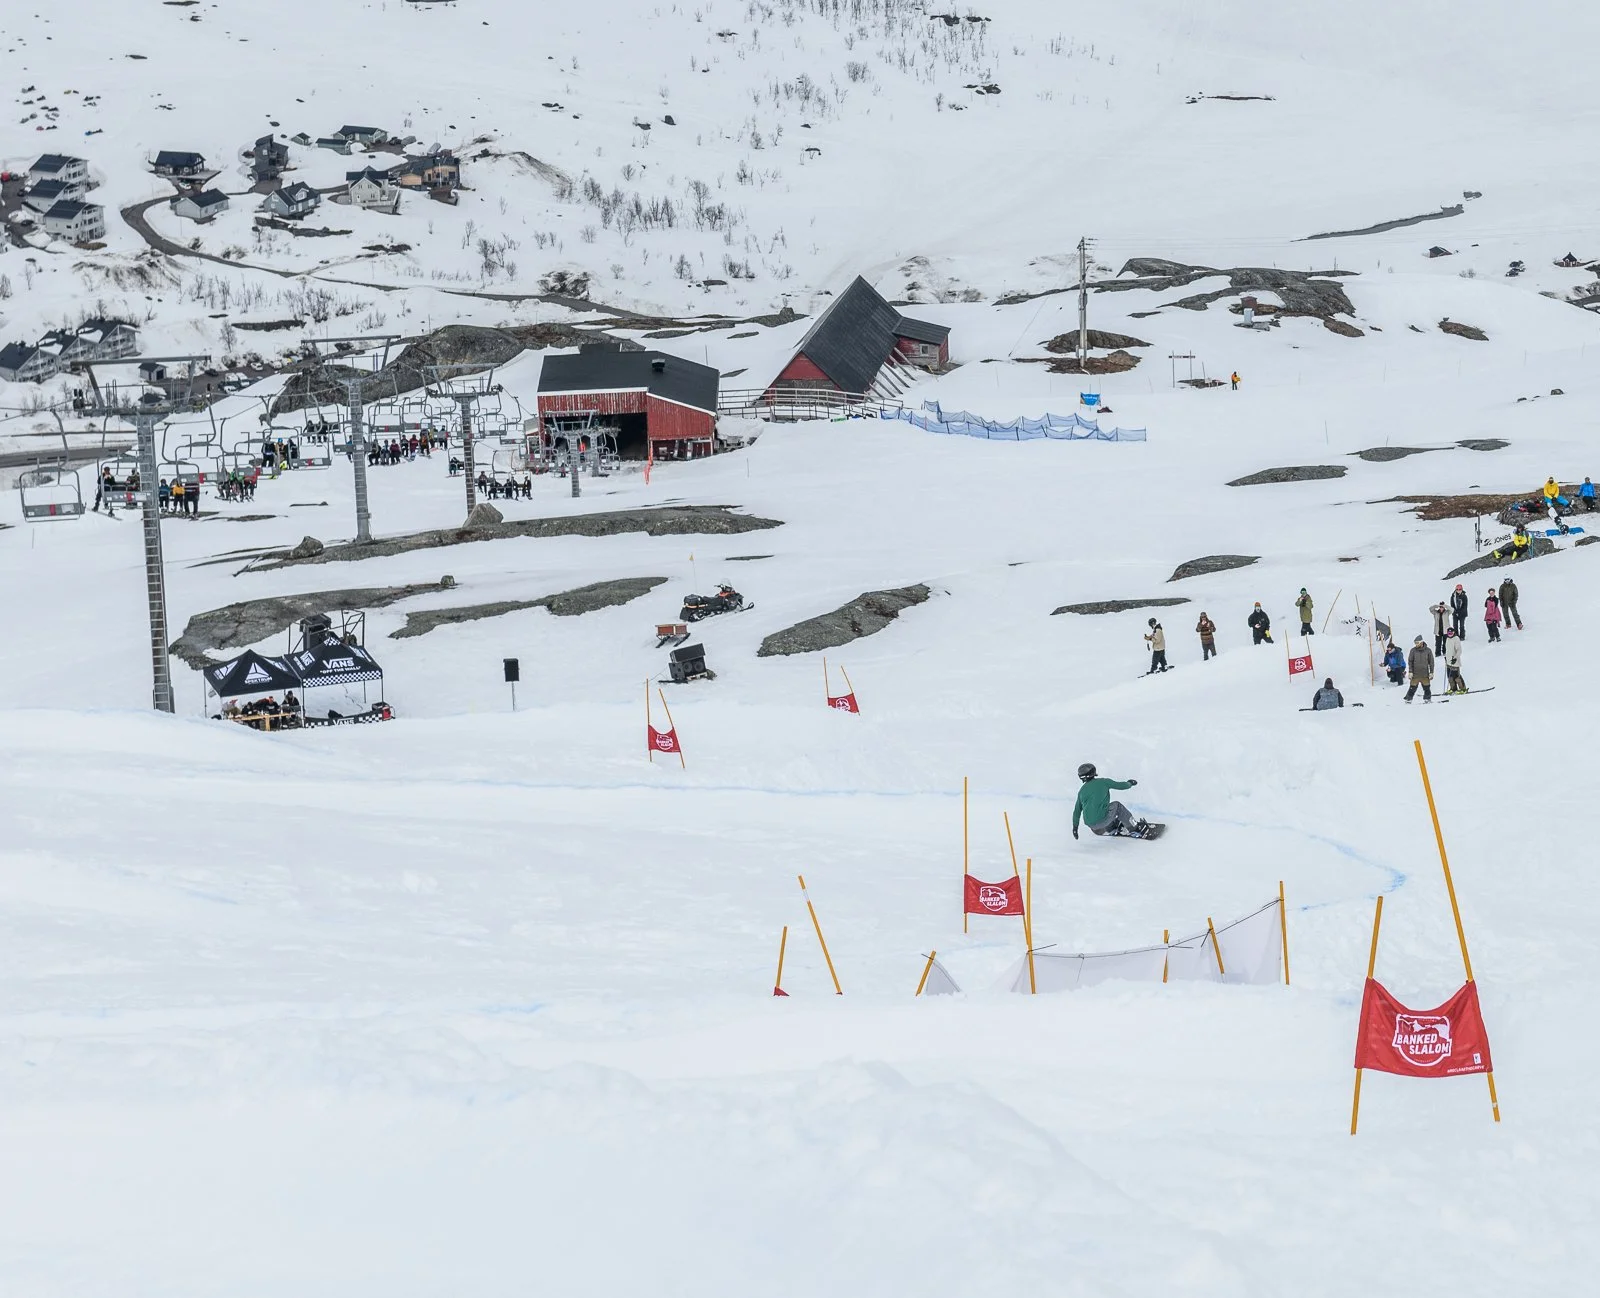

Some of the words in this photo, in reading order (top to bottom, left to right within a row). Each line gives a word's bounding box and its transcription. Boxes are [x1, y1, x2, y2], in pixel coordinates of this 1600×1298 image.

[322, 657, 355, 669] VANS
[1396, 1033, 1438, 1044] BANKED
[1409, 1042, 1449, 1055] SLALOM
